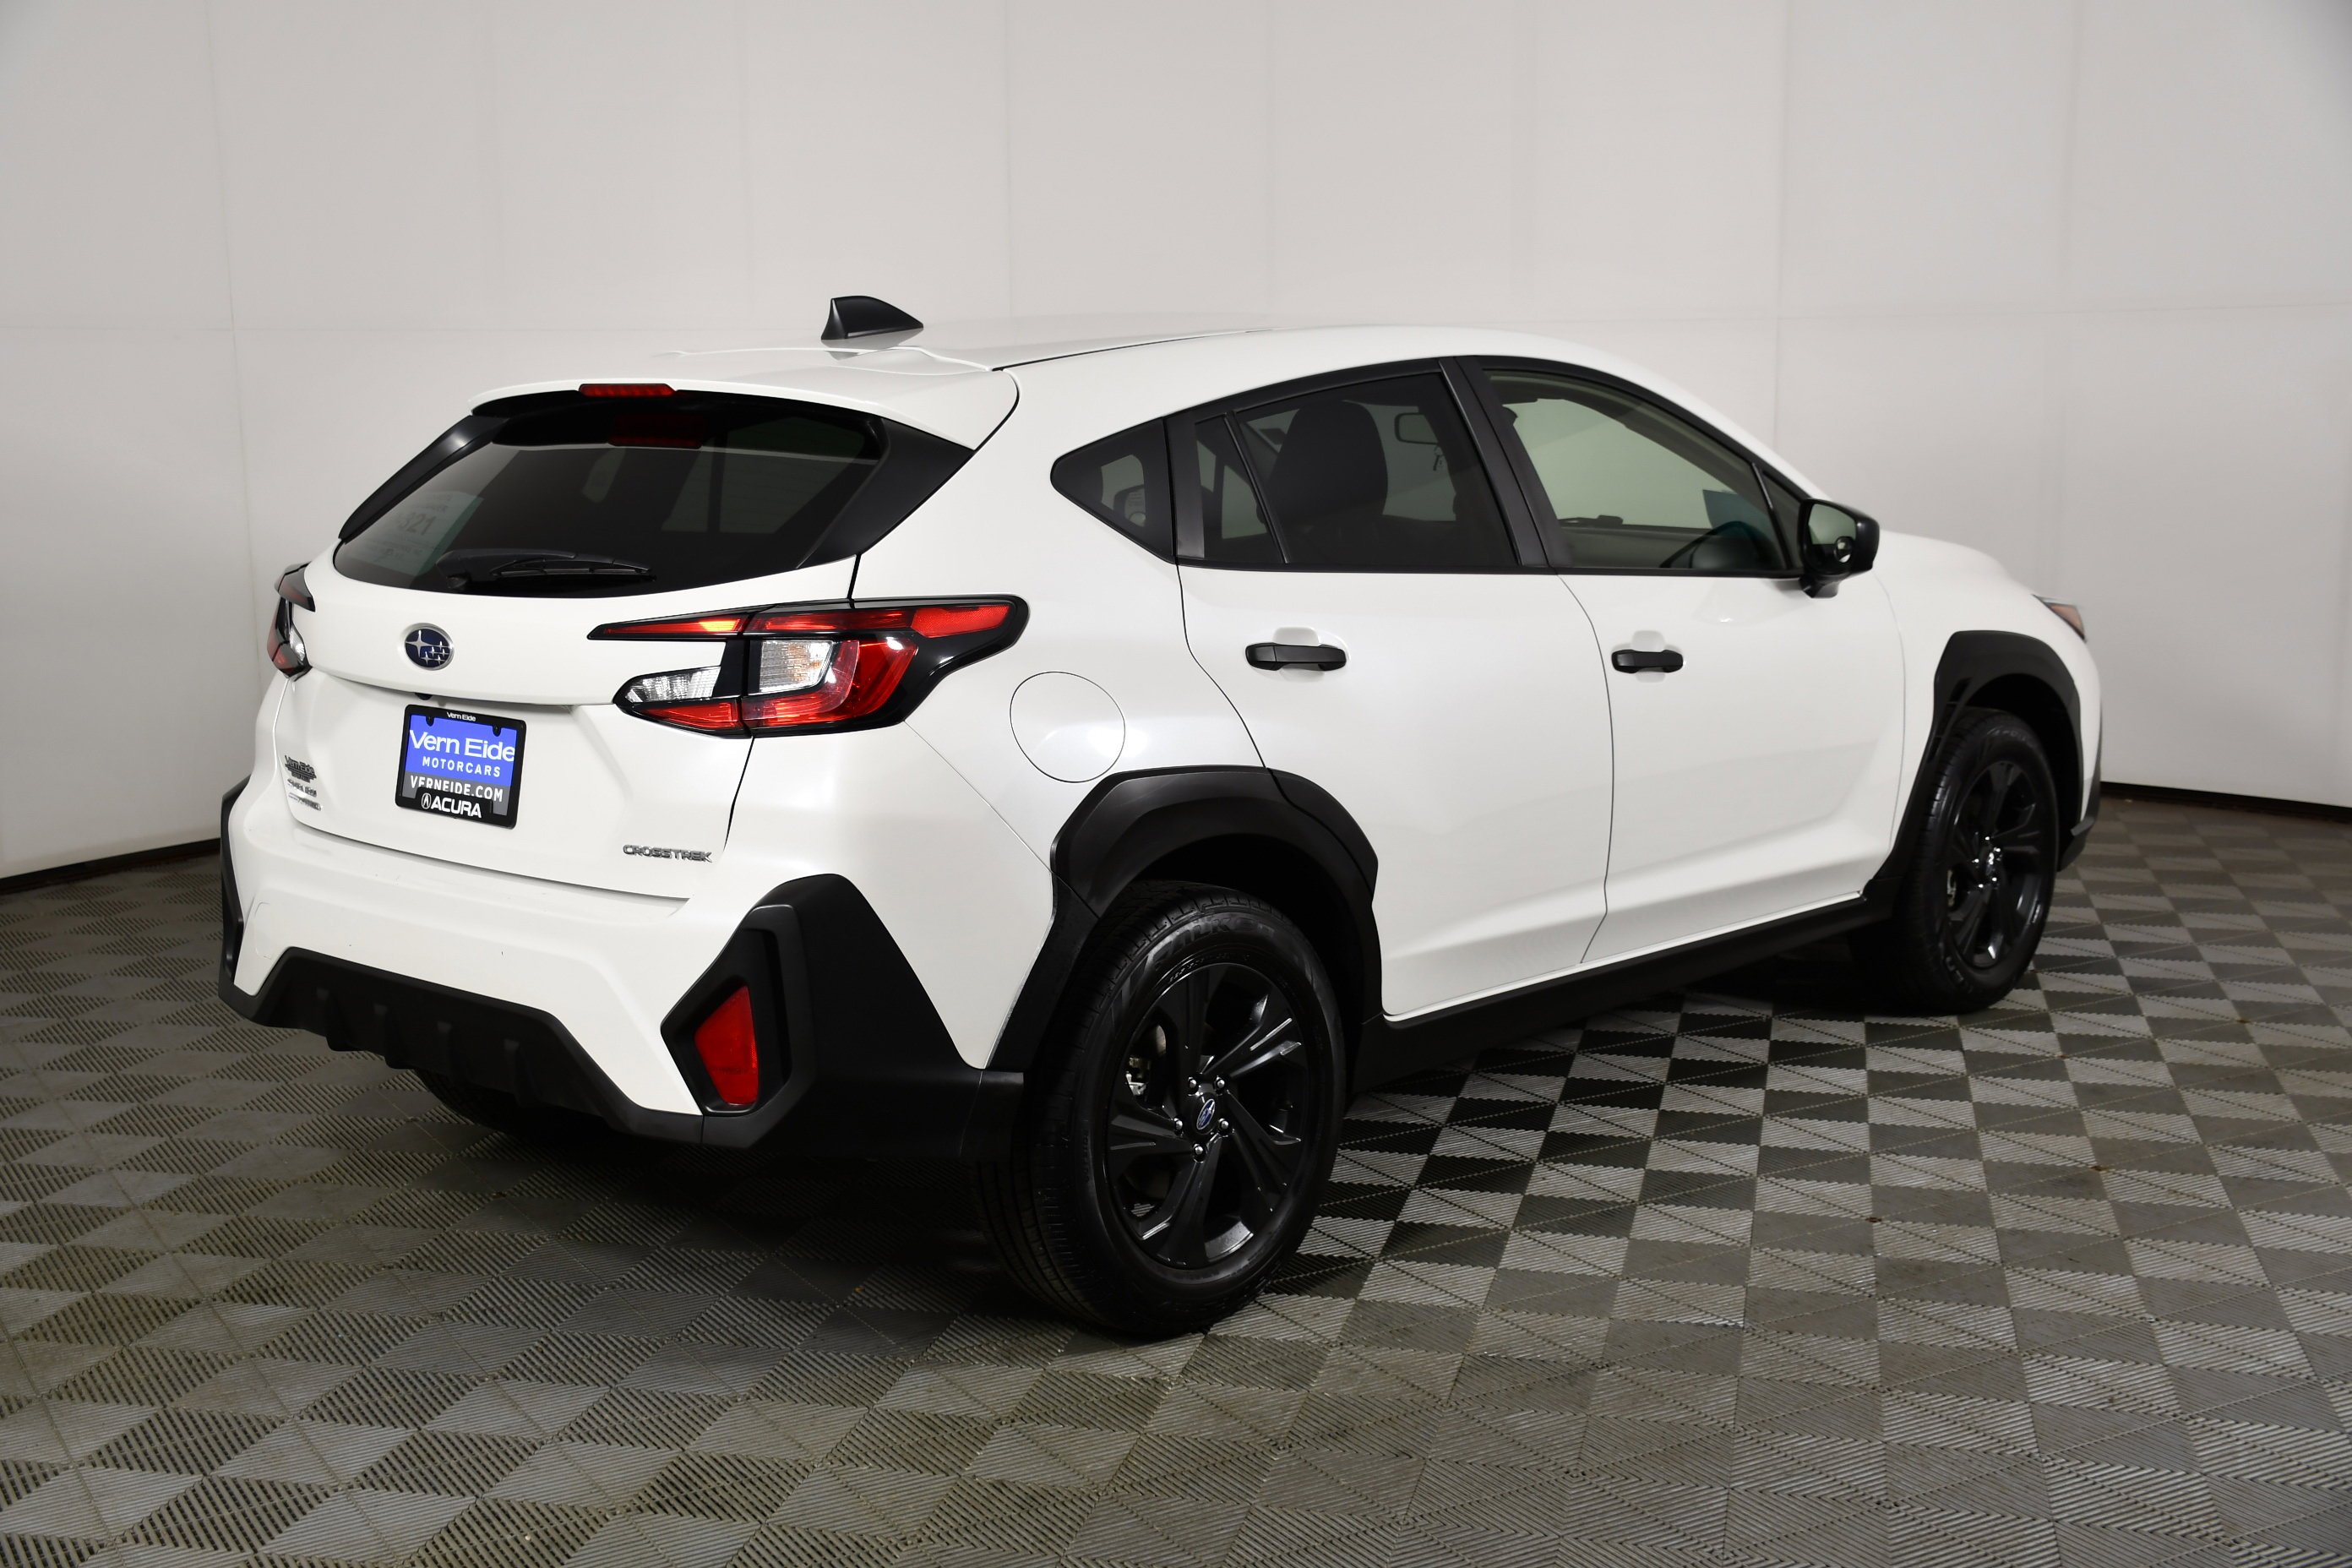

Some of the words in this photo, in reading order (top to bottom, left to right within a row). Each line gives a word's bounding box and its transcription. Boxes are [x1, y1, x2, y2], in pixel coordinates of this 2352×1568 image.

[446, 711, 461, 720] Vern
[462, 714, 476, 722] Eide
[410, 729, 460, 754] Vern
[465, 737, 515, 762] Eide
[422, 756, 501, 777] MOTORCARS
[411, 775, 504, 802] VERNEIDE.COM
[430, 796, 482, 818] ACURA
[623, 844, 713, 863] CROSSTREK
